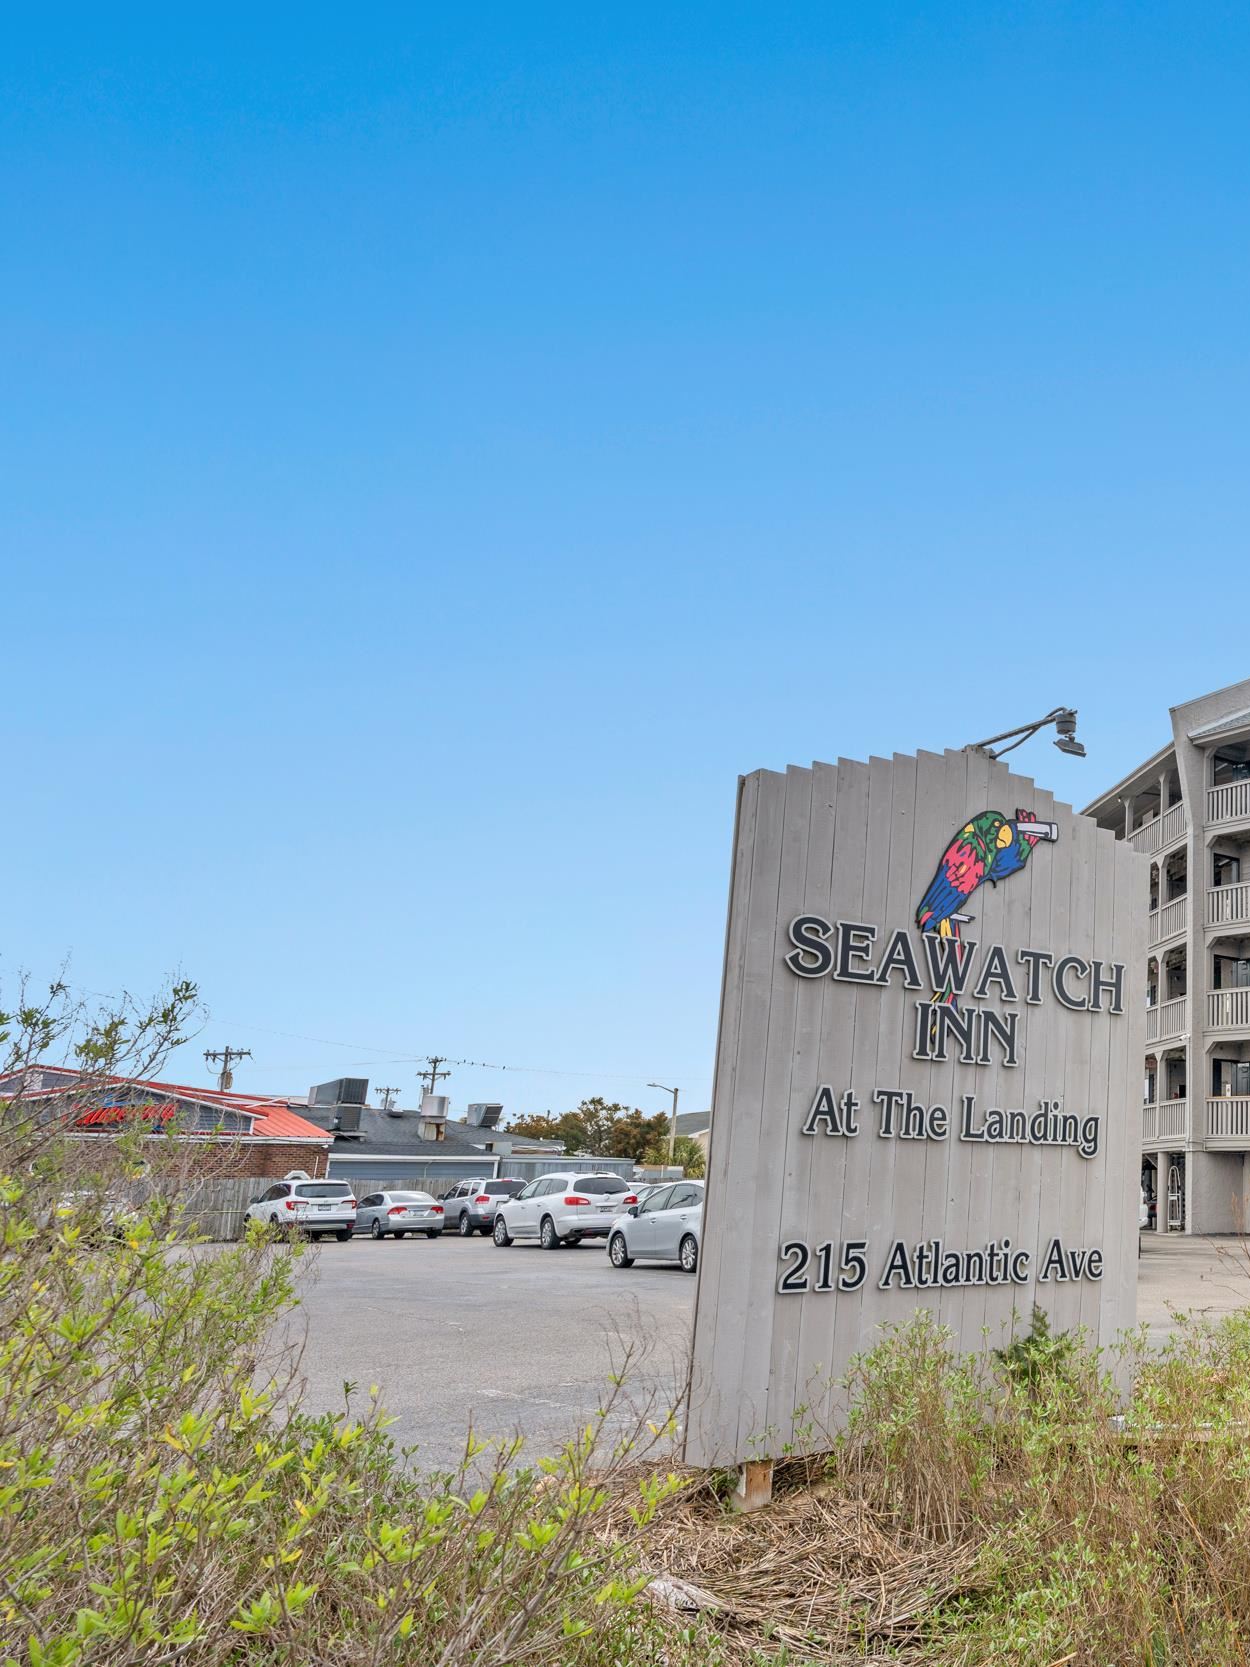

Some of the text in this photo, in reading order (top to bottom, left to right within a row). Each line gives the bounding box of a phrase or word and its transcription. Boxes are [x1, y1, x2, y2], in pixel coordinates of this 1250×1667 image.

[785, 914, 1125, 1014] SEAWATCH
[913, 1000, 1019, 1067] INN
[803, 1085, 1101, 1159] At The Landing
[778, 1237, 1104, 1294] 215 Atlantic Ave
